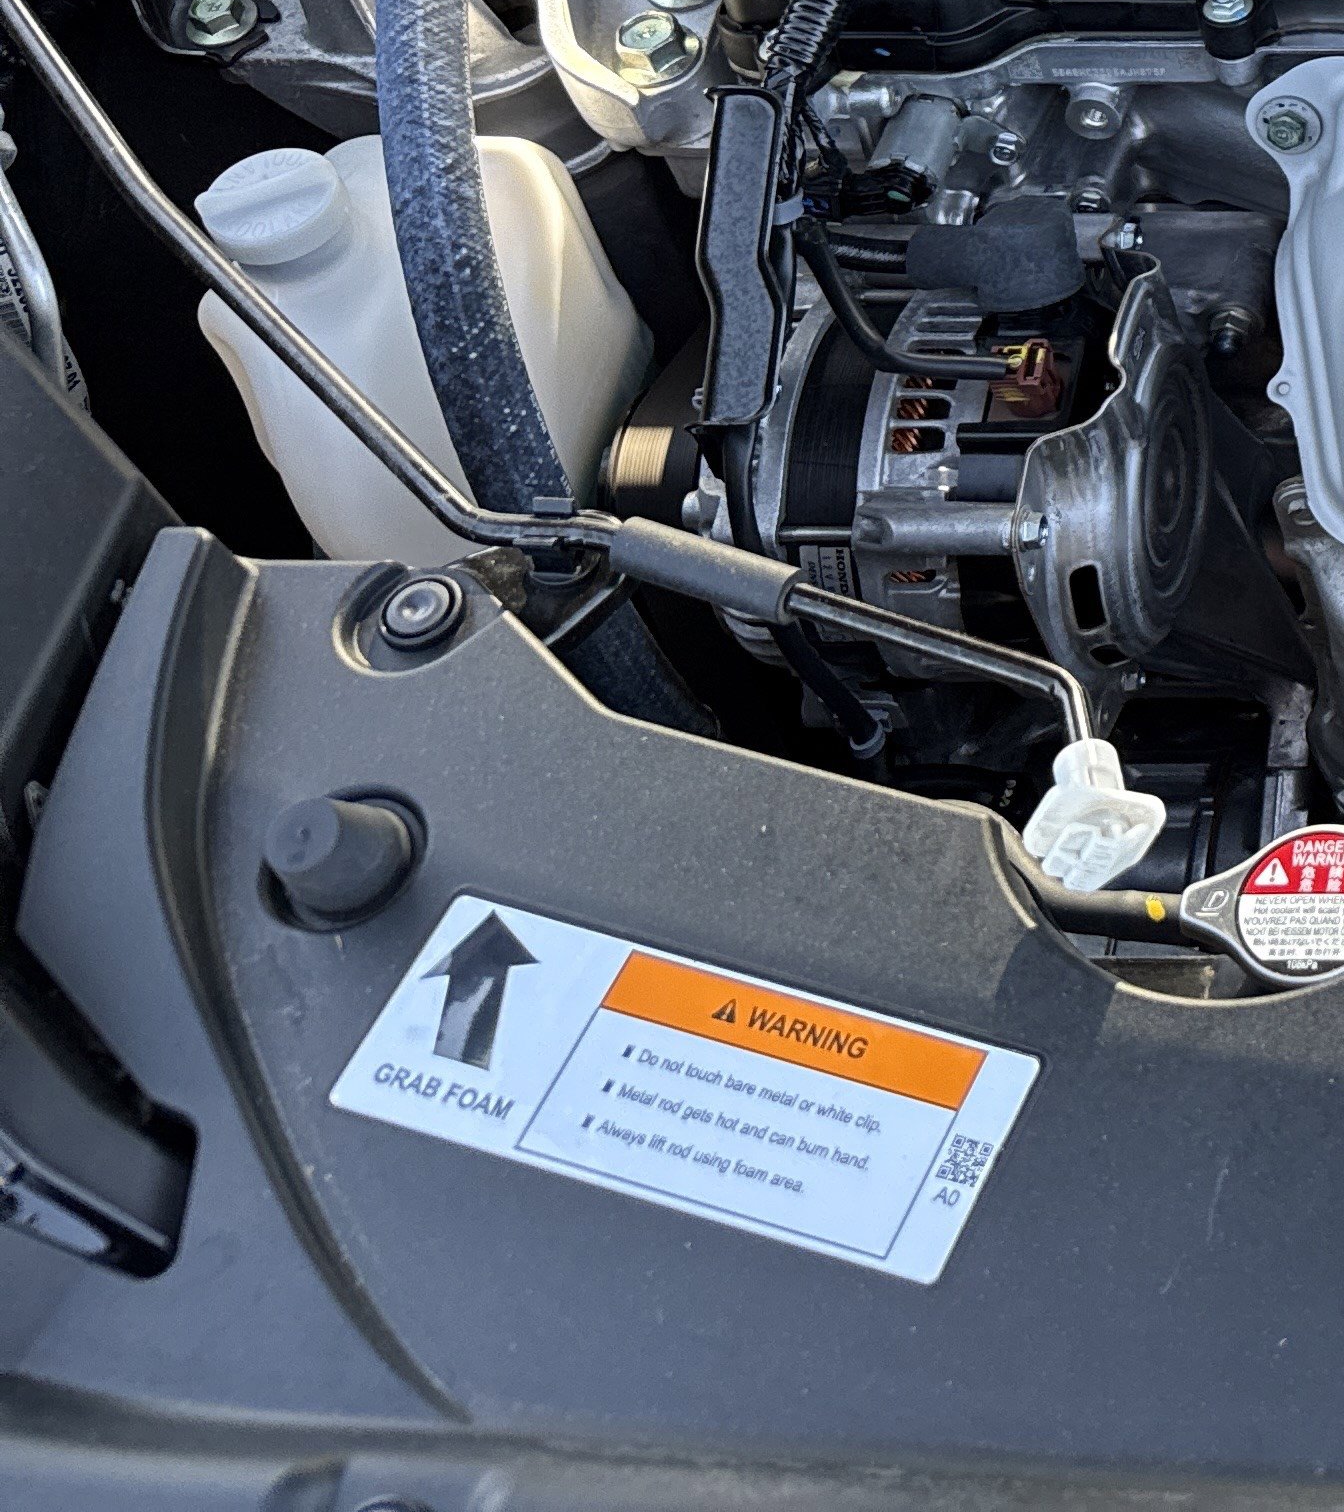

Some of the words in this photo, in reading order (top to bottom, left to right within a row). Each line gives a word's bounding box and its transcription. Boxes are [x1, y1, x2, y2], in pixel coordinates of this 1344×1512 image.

[835, 548, 849, 594] HOND
[1255, 896, 1287, 904] NEVER
[1290, 896, 1316, 904] OPEN
[1290, 916, 1307, 925] PAS
[1309, 916, 1340, 926] QUAND
[746, 1006, 870, 1060] WARNING
[373, 1062, 442, 1099] GRAB
[442, 1080, 515, 1120] FOAM
[637, 1048, 658, 1066] Do
[661, 1059, 685, 1074] not
[685, 1062, 723, 1085] touch
[724, 1074, 757, 1095] bare
[758, 1086, 800, 1108] metal
[799, 1098, 816, 1113] or
[816, 1102, 853, 1124] white
[854, 1114, 882, 1135] clip.
[617, 1083, 658, 1106] Metal
[658, 1099, 685, 1114] rod
[681, 1105, 714, 1124] gets
[715, 1111, 740, 1131] hot
[740, 1122, 769, 1139] and
[768, 1130, 795, 1149] can
[796, 1136, 830, 1160] burn
[832, 1146, 869, 1172] hand.
[597, 1120, 647, 1146] Always
[647, 1133, 667, 1152] lift
[666, 1142, 694, 1159] rod
[693, 1150, 732, 1174] using
[732, 1159, 769, 1182] foam
[770, 1173, 804, 1194] area.
[932, 1186, 961, 1208] A0
